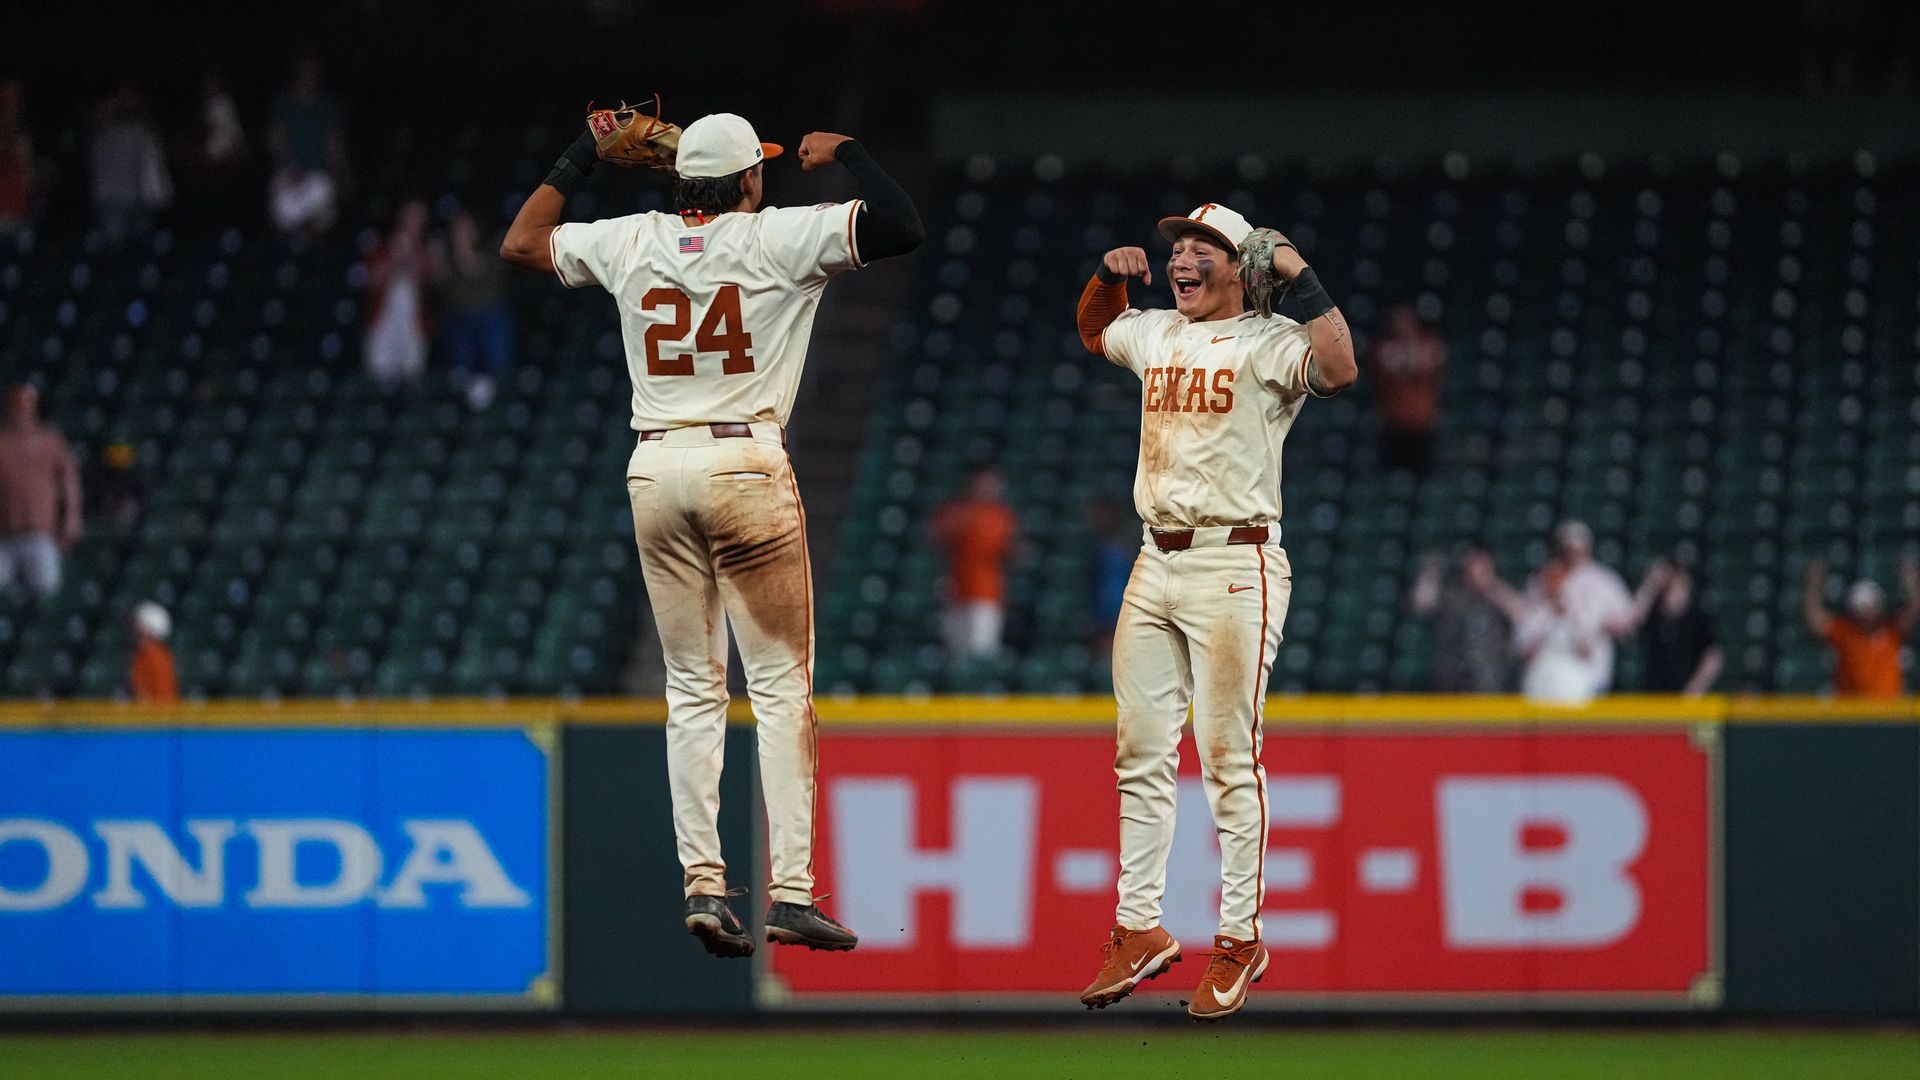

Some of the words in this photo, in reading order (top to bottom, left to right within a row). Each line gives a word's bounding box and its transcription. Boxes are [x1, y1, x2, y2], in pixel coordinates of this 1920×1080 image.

[1195, 203, 1217, 221] T
[642, 285, 755, 376] 24
[831, 776, 1648, 948] H-E-B
